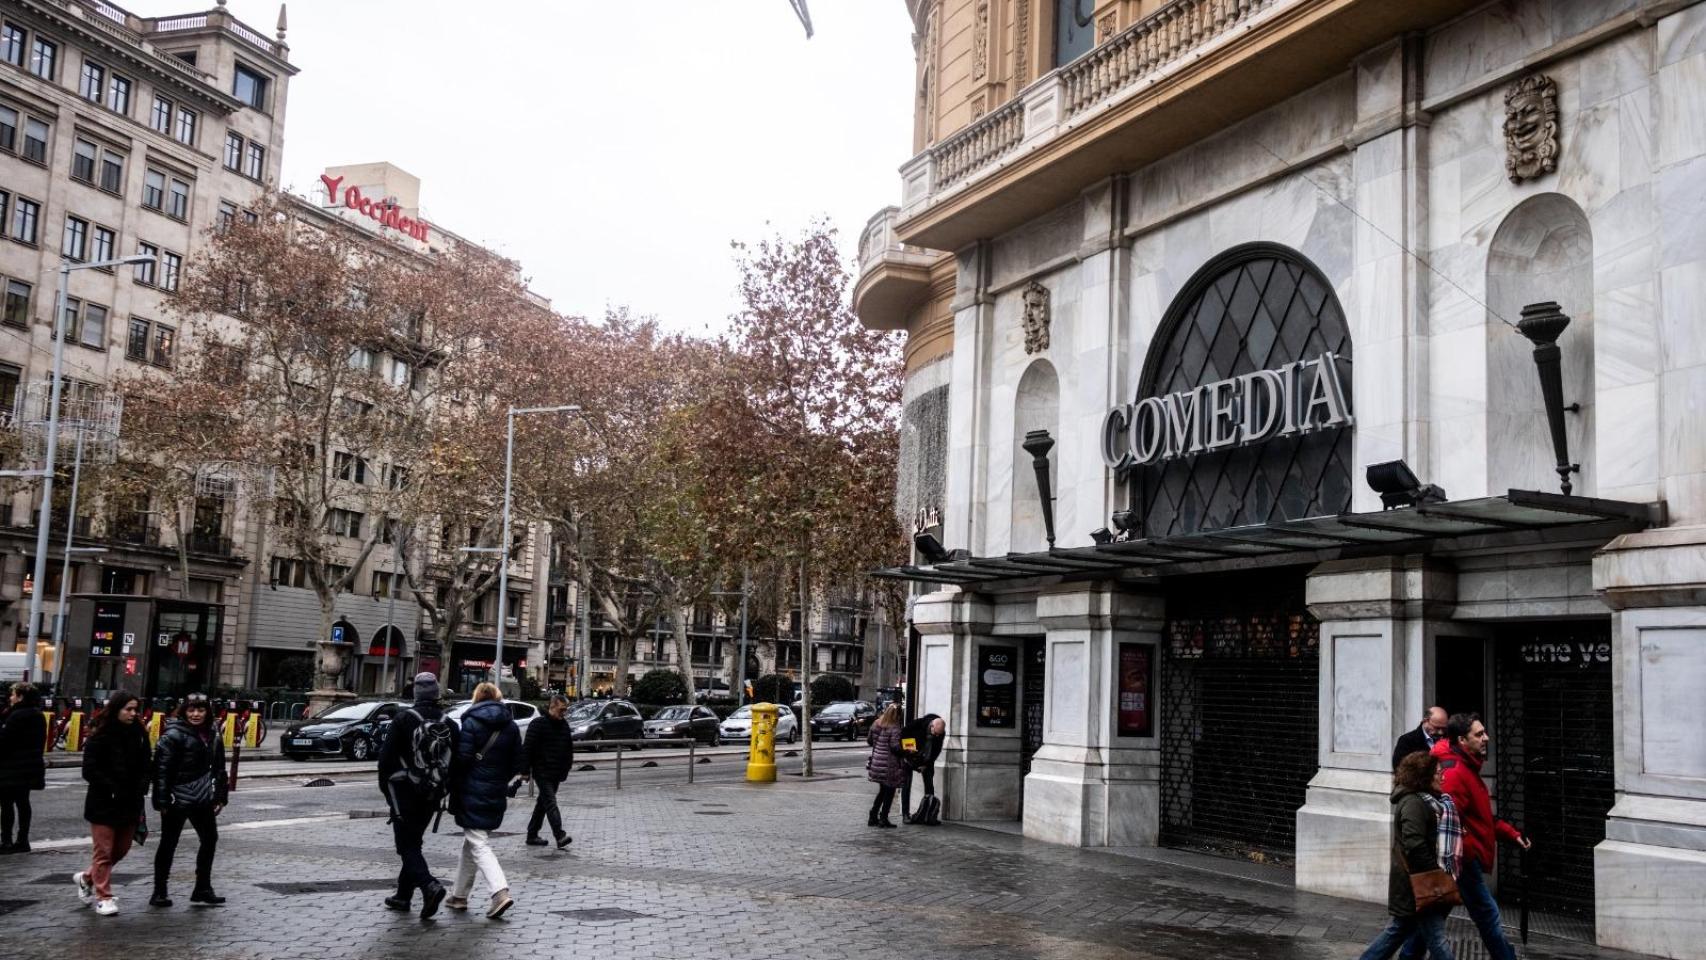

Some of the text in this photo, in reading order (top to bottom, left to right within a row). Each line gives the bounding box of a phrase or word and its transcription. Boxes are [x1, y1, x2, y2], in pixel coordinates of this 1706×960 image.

[345, 185, 428, 243] Occident
[1100, 351, 1353, 469] COMEDIA
[177, 641, 189, 655] M
